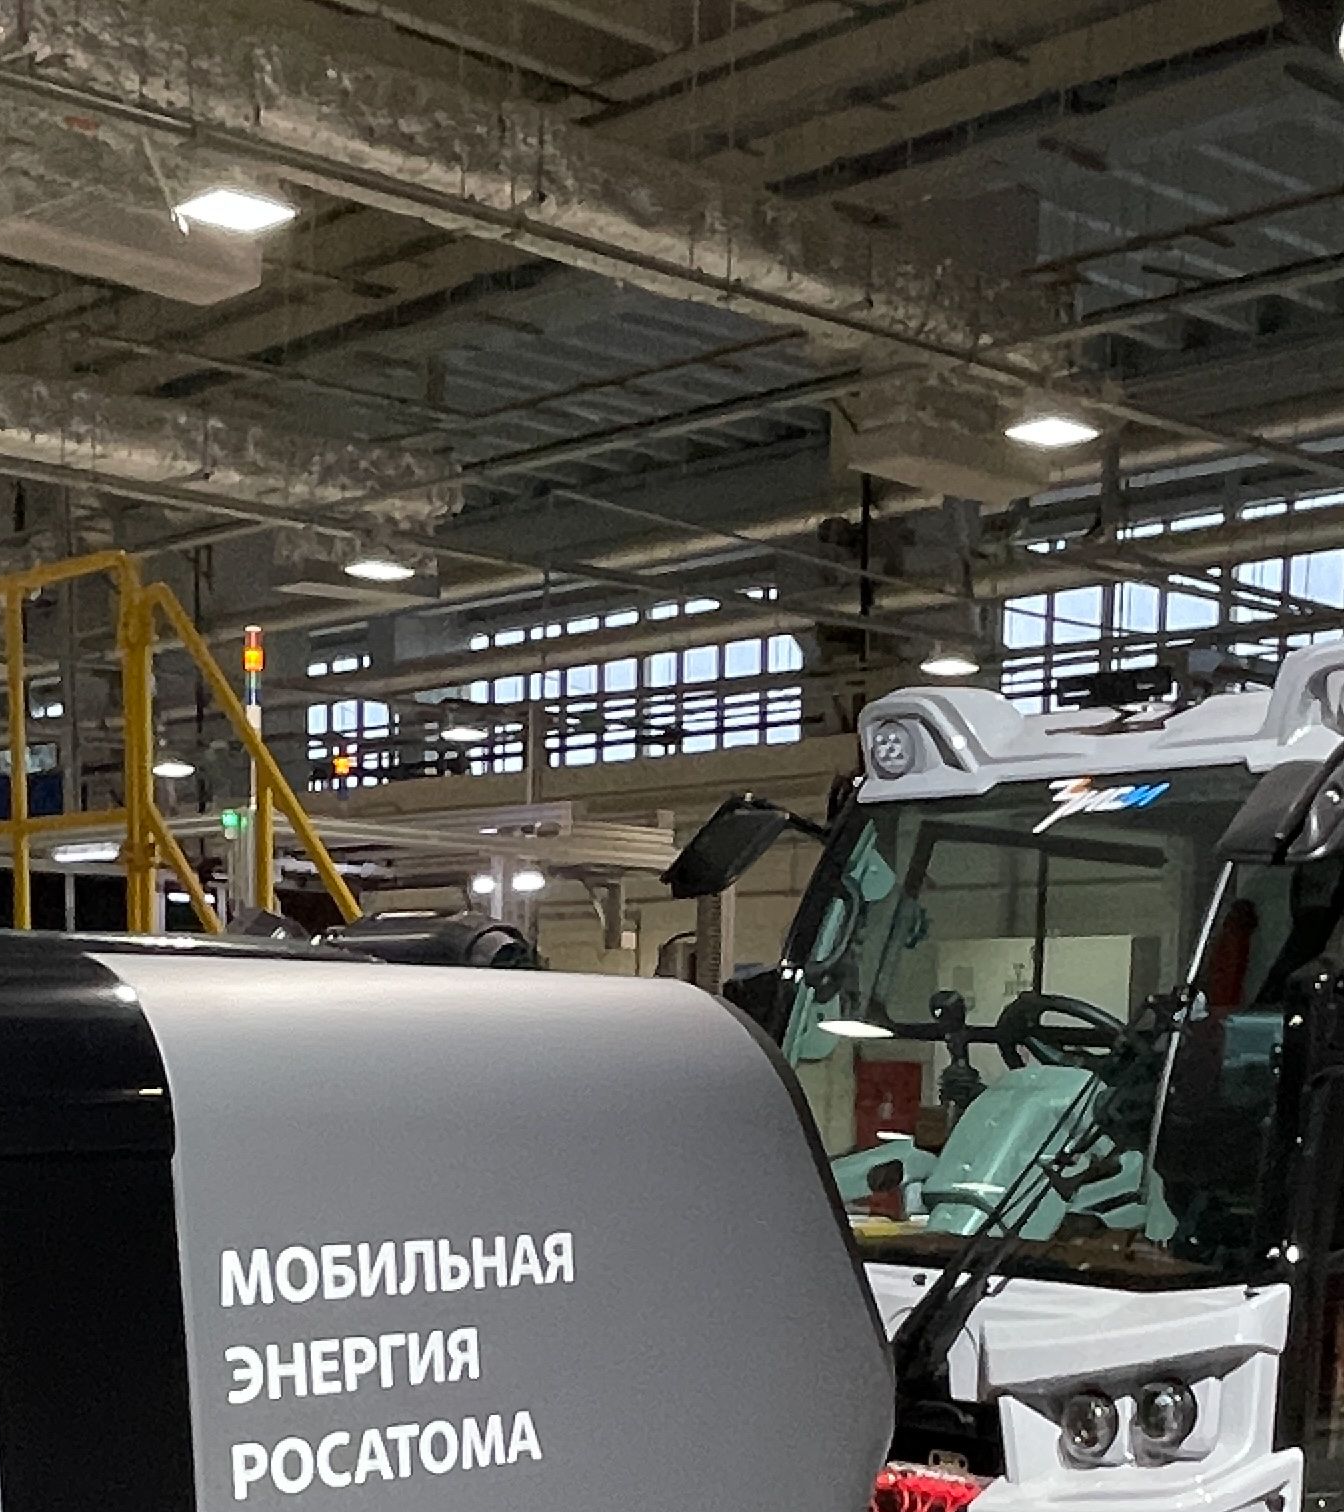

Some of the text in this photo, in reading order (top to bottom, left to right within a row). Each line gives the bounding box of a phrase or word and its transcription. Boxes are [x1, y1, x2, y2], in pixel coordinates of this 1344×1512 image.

[220, 1231, 575, 1308] МОБИЛЬНАЯ
[224, 1326, 481, 1405] ЭНЕРГИЯ
[231, 1410, 544, 1501] РОСАТОМА
